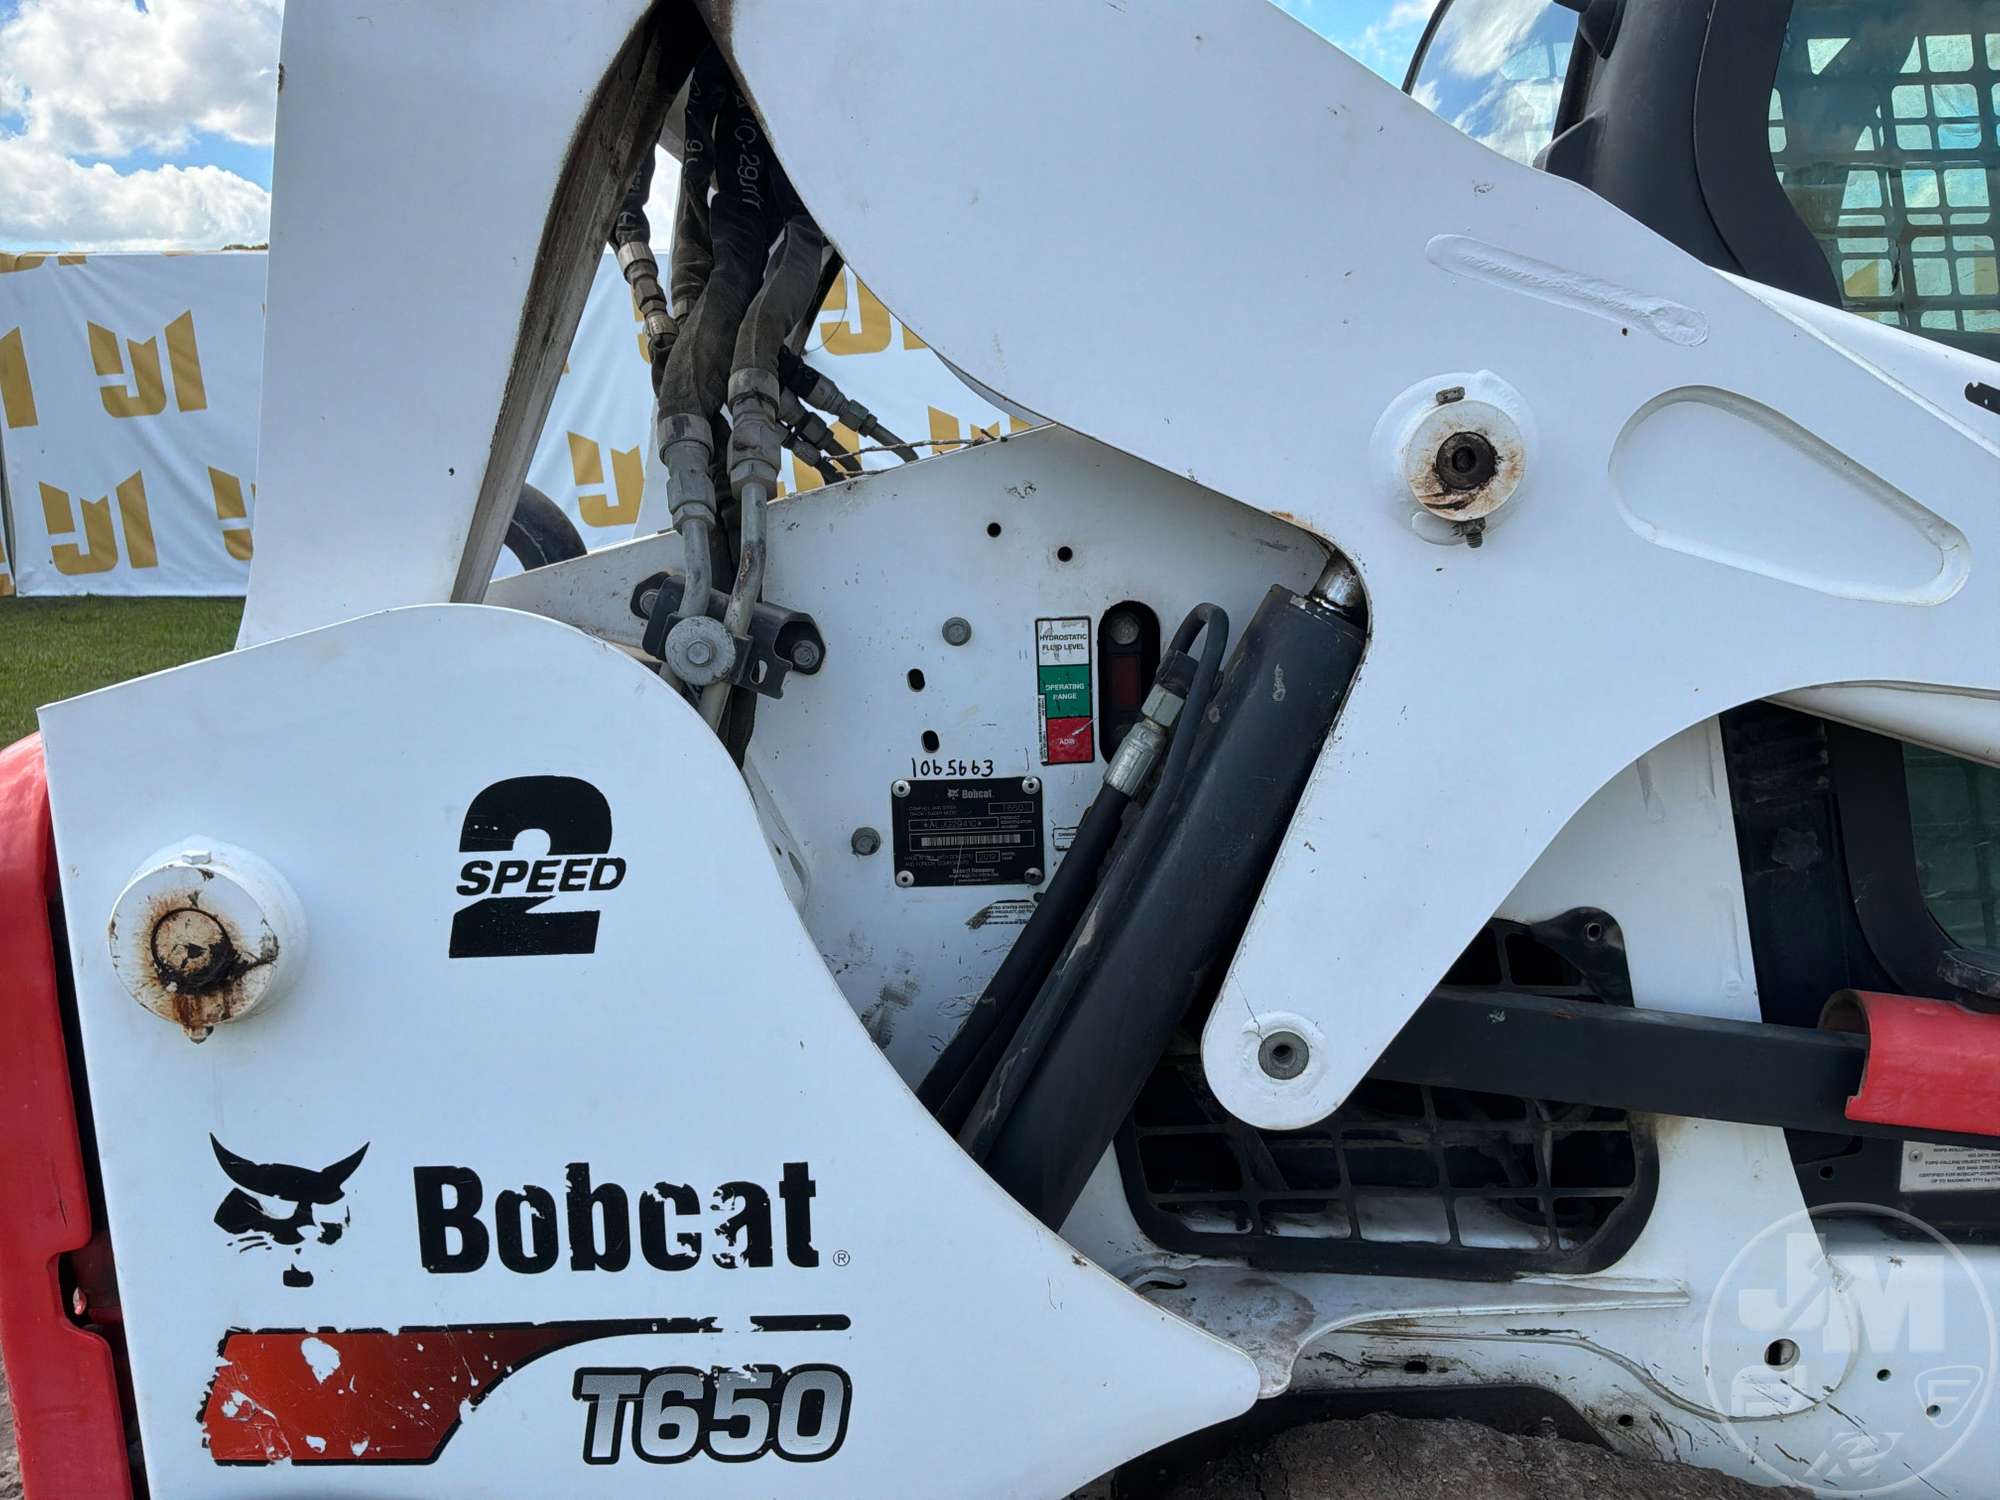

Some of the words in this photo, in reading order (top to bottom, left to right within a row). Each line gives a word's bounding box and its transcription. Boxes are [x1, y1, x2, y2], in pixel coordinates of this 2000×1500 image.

[1039, 633, 1088, 642] HYDROSTATIC
[1064, 643, 1086, 651] LEVEL
[1045, 683, 1085, 691] OPERATING
[1053, 692, 1078, 700] RANGE
[911, 757, 995, 778] 1065663
[962, 788, 992, 799] Bobcat
[456, 857, 627, 897] SPEED
[413, 1161, 819, 1274] Bobcat
[573, 1363, 852, 1466] T650
